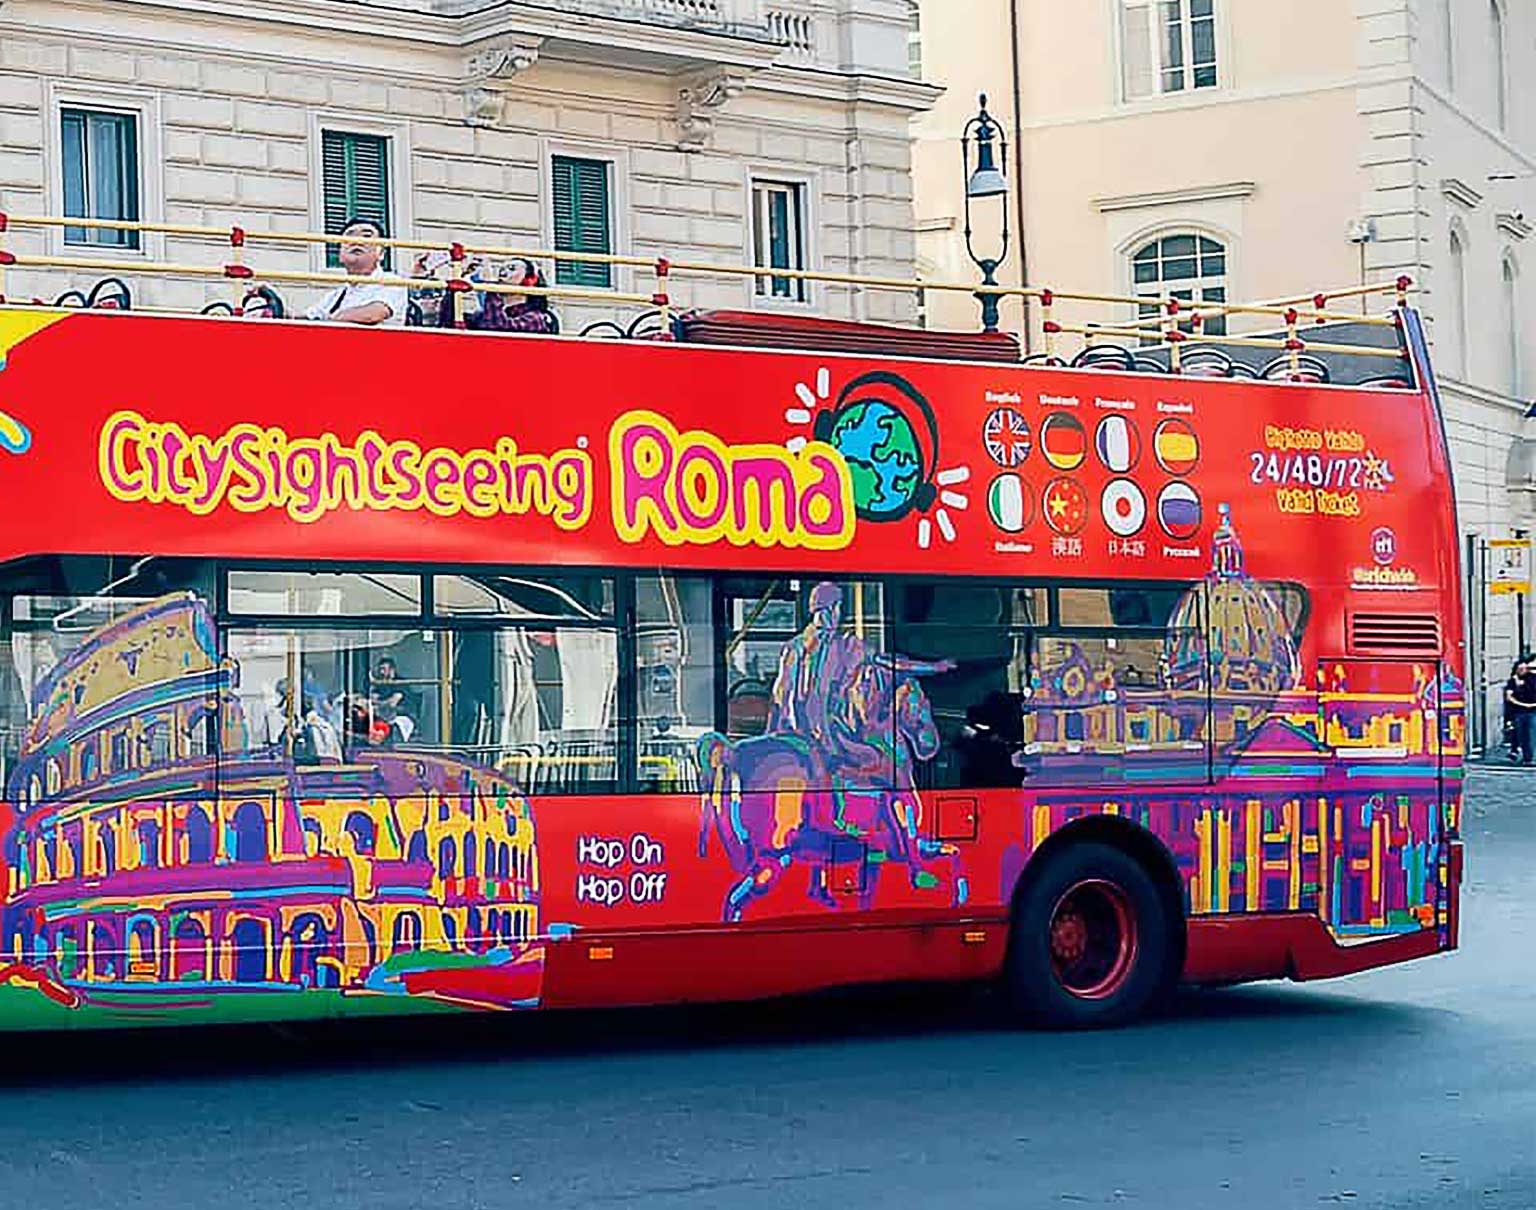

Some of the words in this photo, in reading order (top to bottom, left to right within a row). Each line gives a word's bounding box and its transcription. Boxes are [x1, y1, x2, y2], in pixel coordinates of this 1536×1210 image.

[101, 411, 591, 527] CitySightseeing
[612, 411, 854, 548] Roma
[1250, 452, 1362, 488] 24/48/72
[579, 836, 624, 868] Hop
[631, 834, 662, 864] On
[578, 874, 624, 905] Hop
[630, 872, 667, 902] Off
